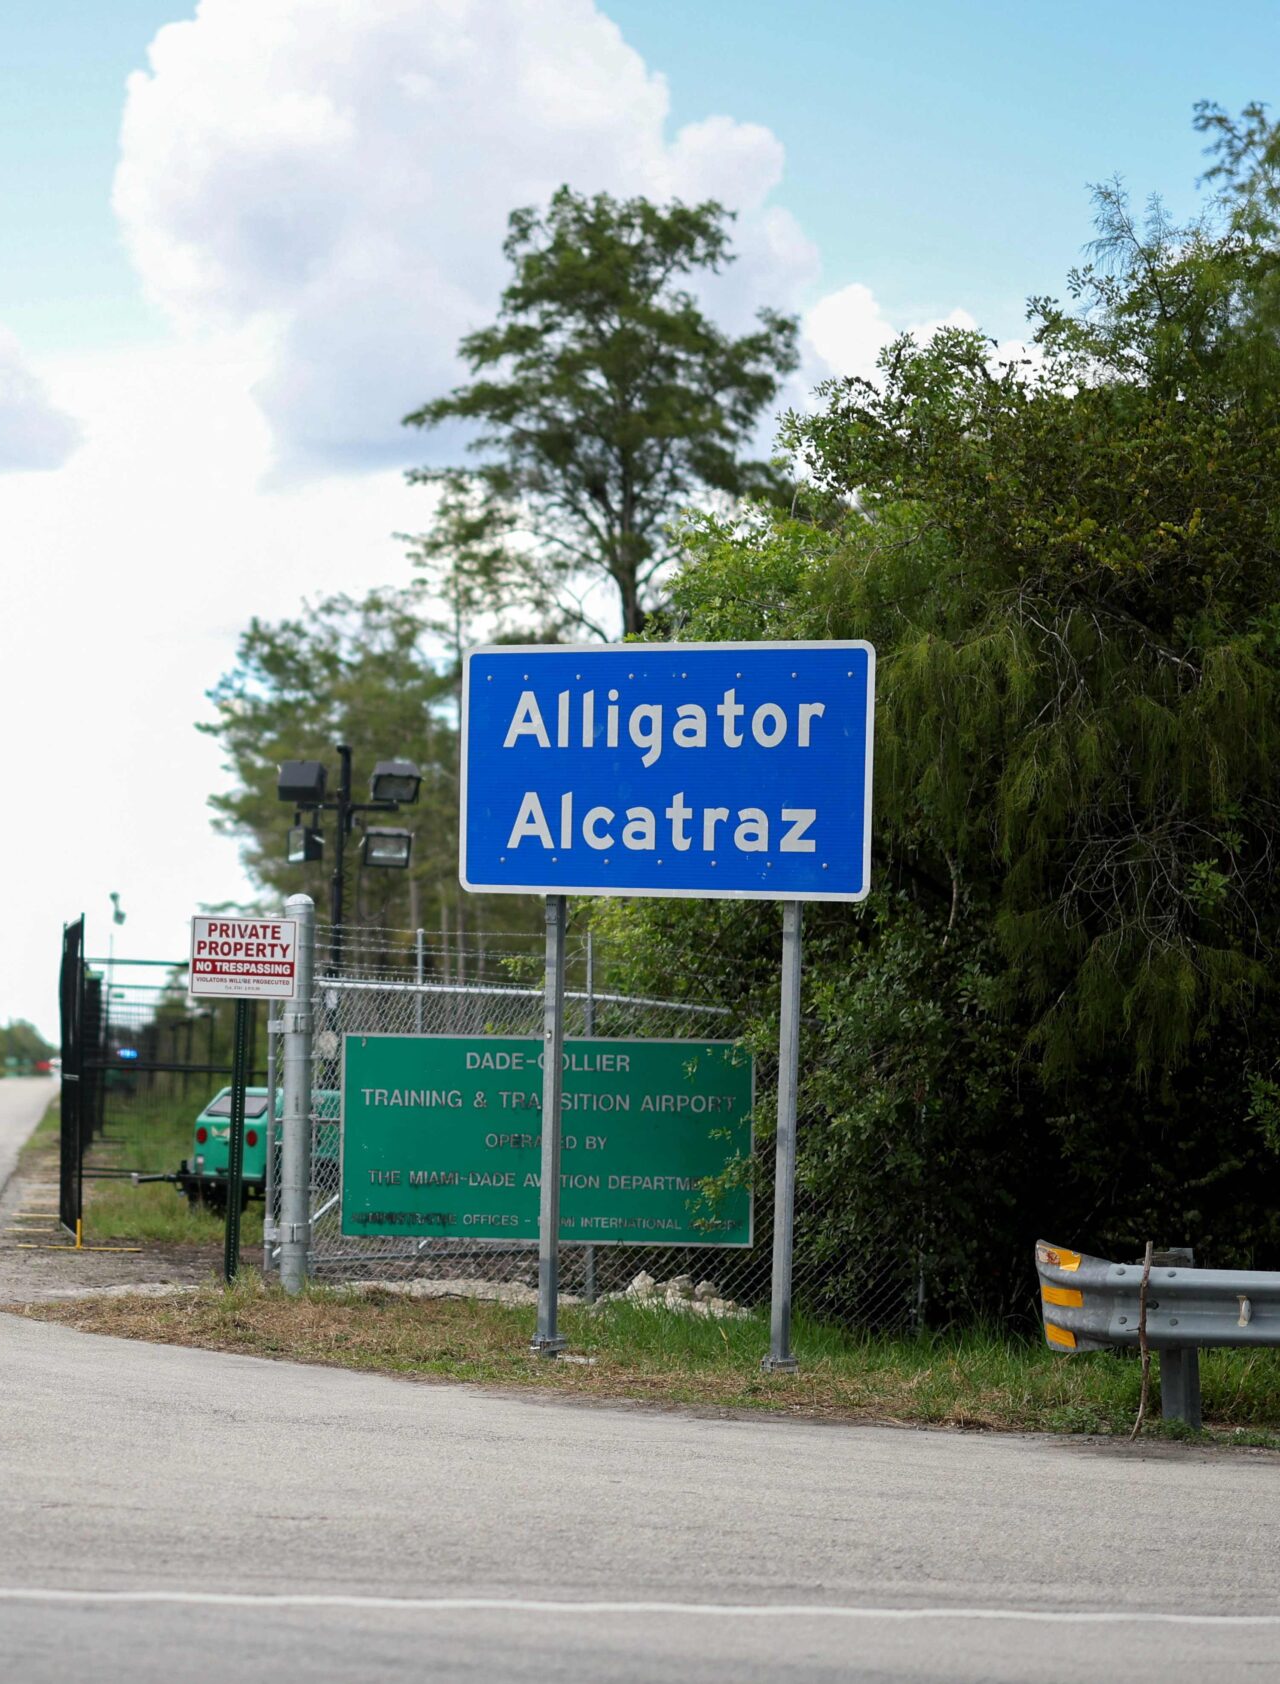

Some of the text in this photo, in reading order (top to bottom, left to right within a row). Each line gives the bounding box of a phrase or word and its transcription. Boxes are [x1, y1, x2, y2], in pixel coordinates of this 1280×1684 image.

[503, 688, 826, 768] Alligator
[507, 791, 817, 853] Alcatraz
[207, 922, 281, 940] PRIVATE
[196, 940, 291, 959] PROPERTY
[195, 961, 291, 975] NO TRESPASSING
[196, 976, 228, 984] VIOLATORS
[252, 978, 290, 986] PROSECUTED
[361, 1088, 736, 1113] TRAINING & TRASITION AIRPORT
[485, 1133, 607, 1150] OPERAD BY
[368, 1170, 702, 1191] THE MIAMI-DADE AVTION DEPARTME
[462, 1213, 519, 1226] OFFICES
[580, 1216, 682, 1231] INTERNATIONAL
